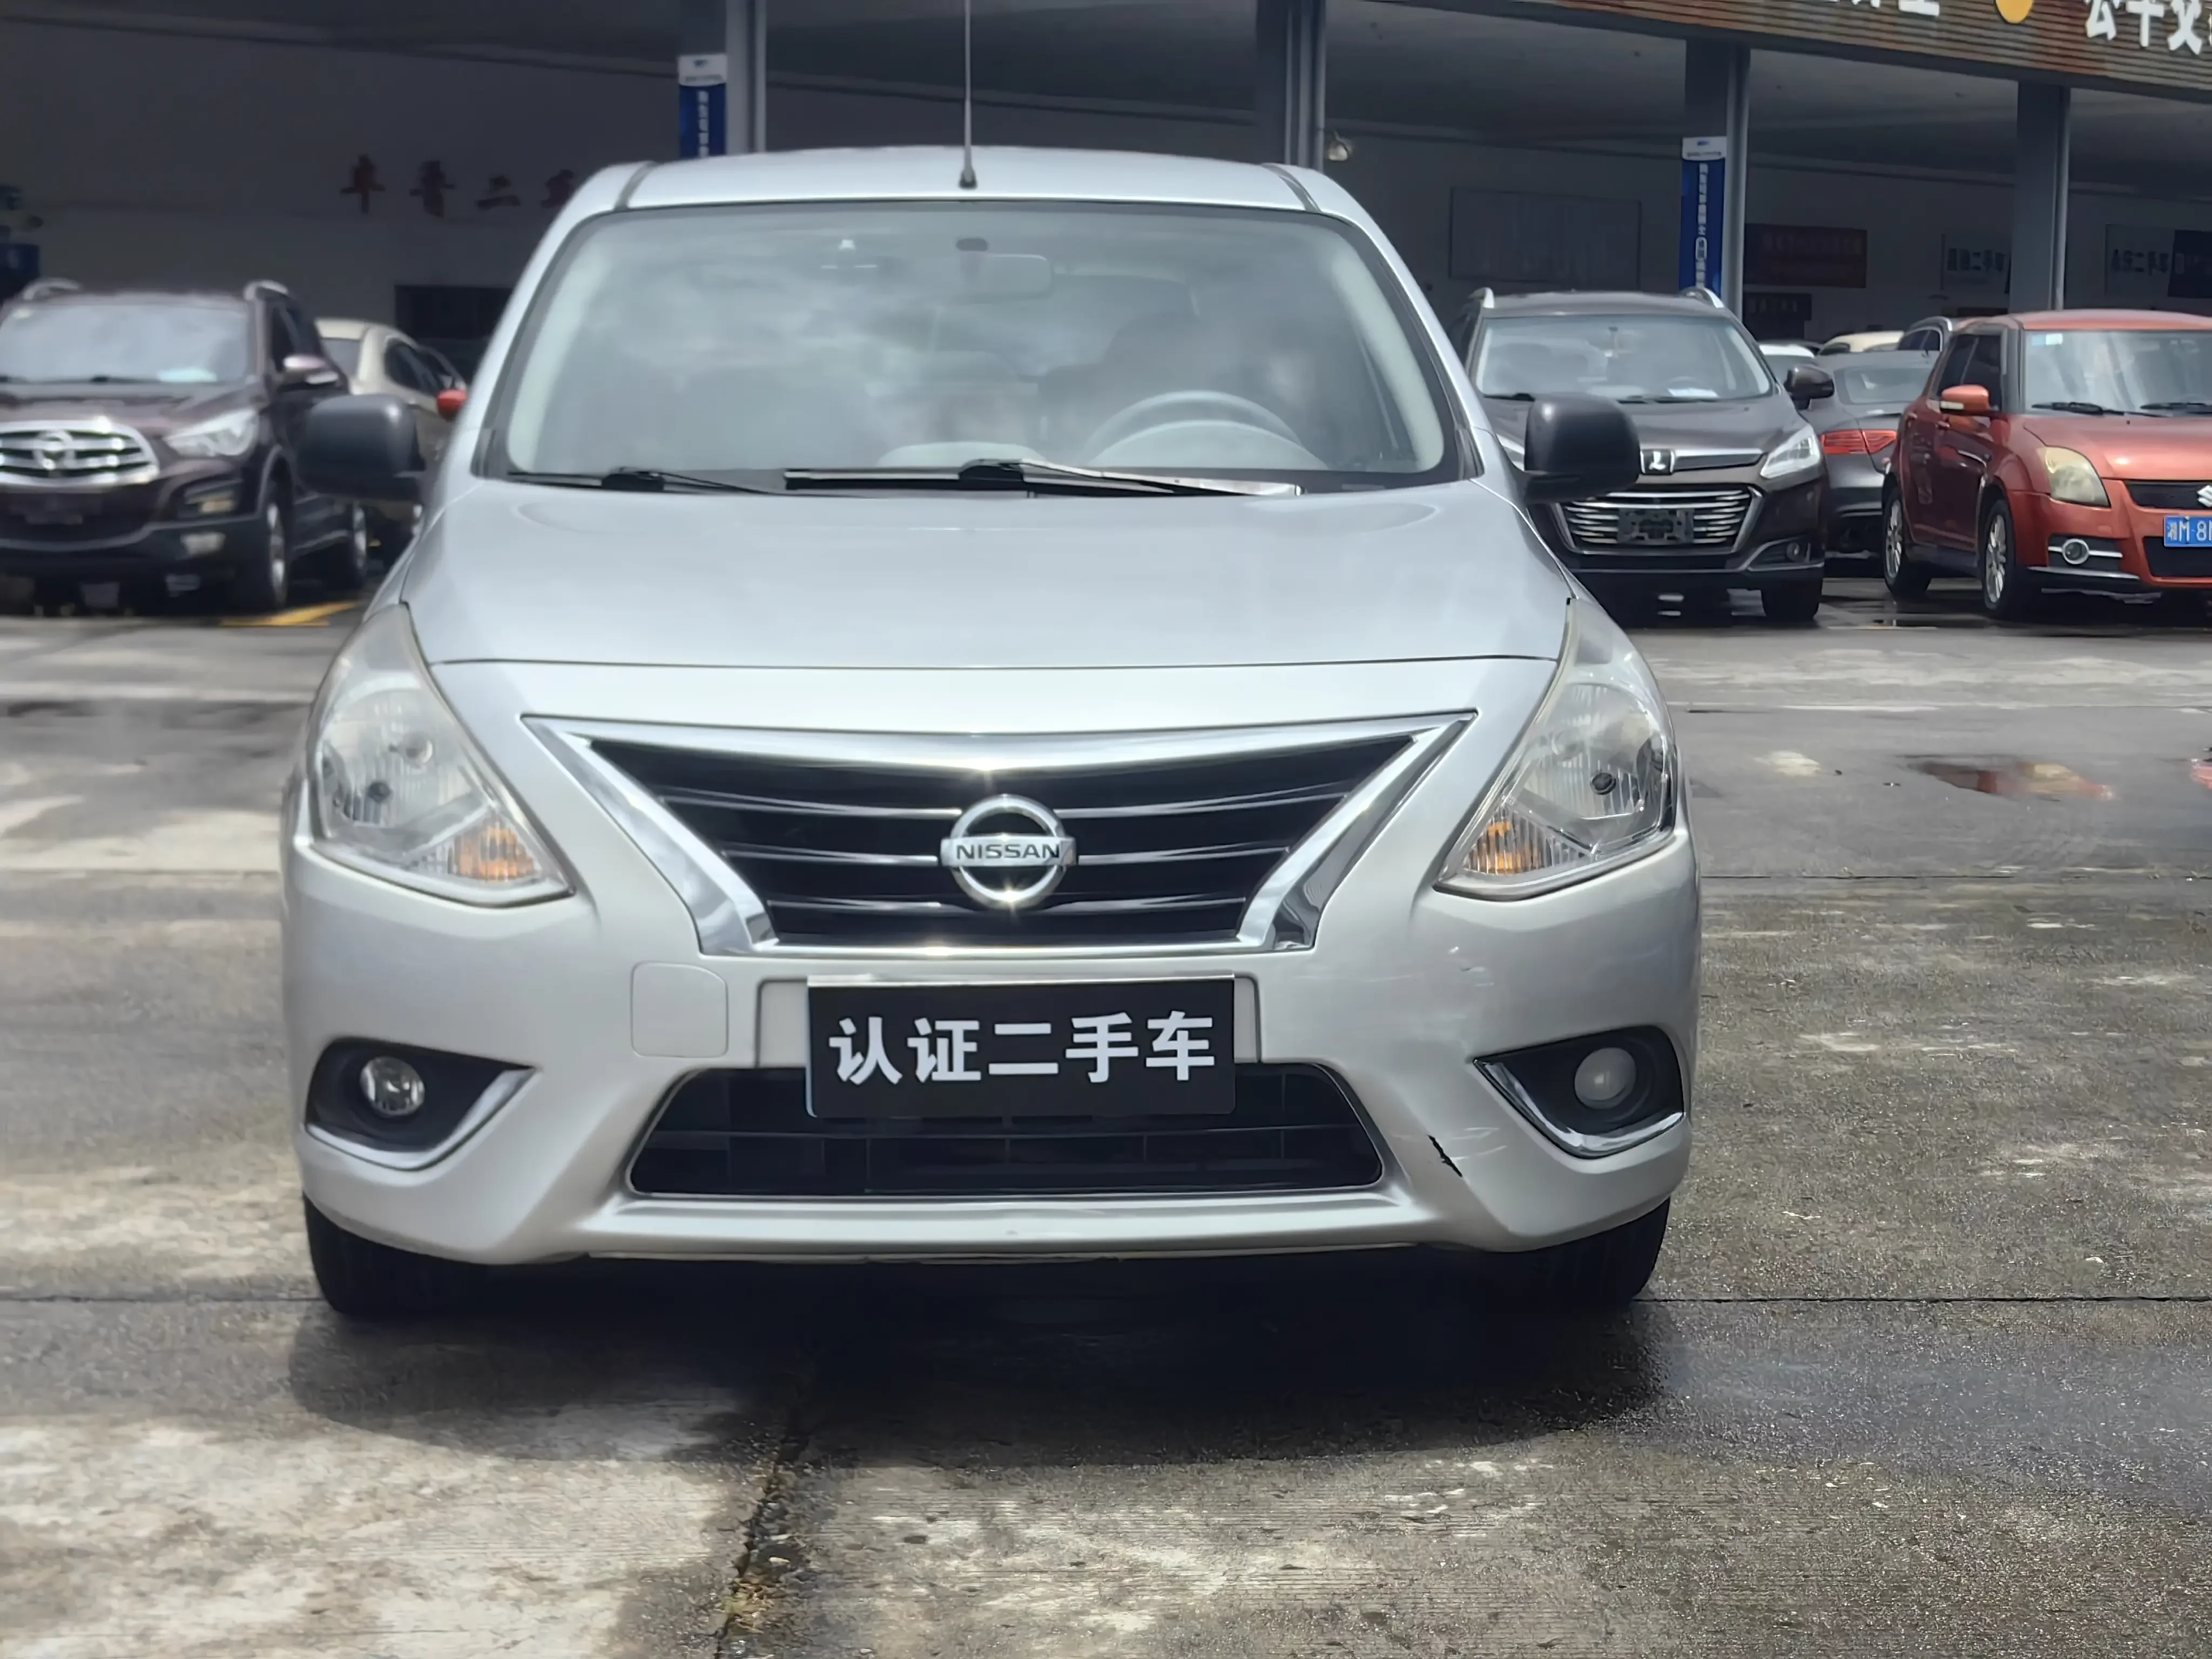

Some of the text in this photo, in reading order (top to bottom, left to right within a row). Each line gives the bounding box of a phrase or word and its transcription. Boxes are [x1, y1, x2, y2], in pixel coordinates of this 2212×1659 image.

[2085, 0, 2212, 55] 公平交
[956, 844, 1060, 859] NISSAN
[829, 1010, 1215, 1084] 认证二手车
